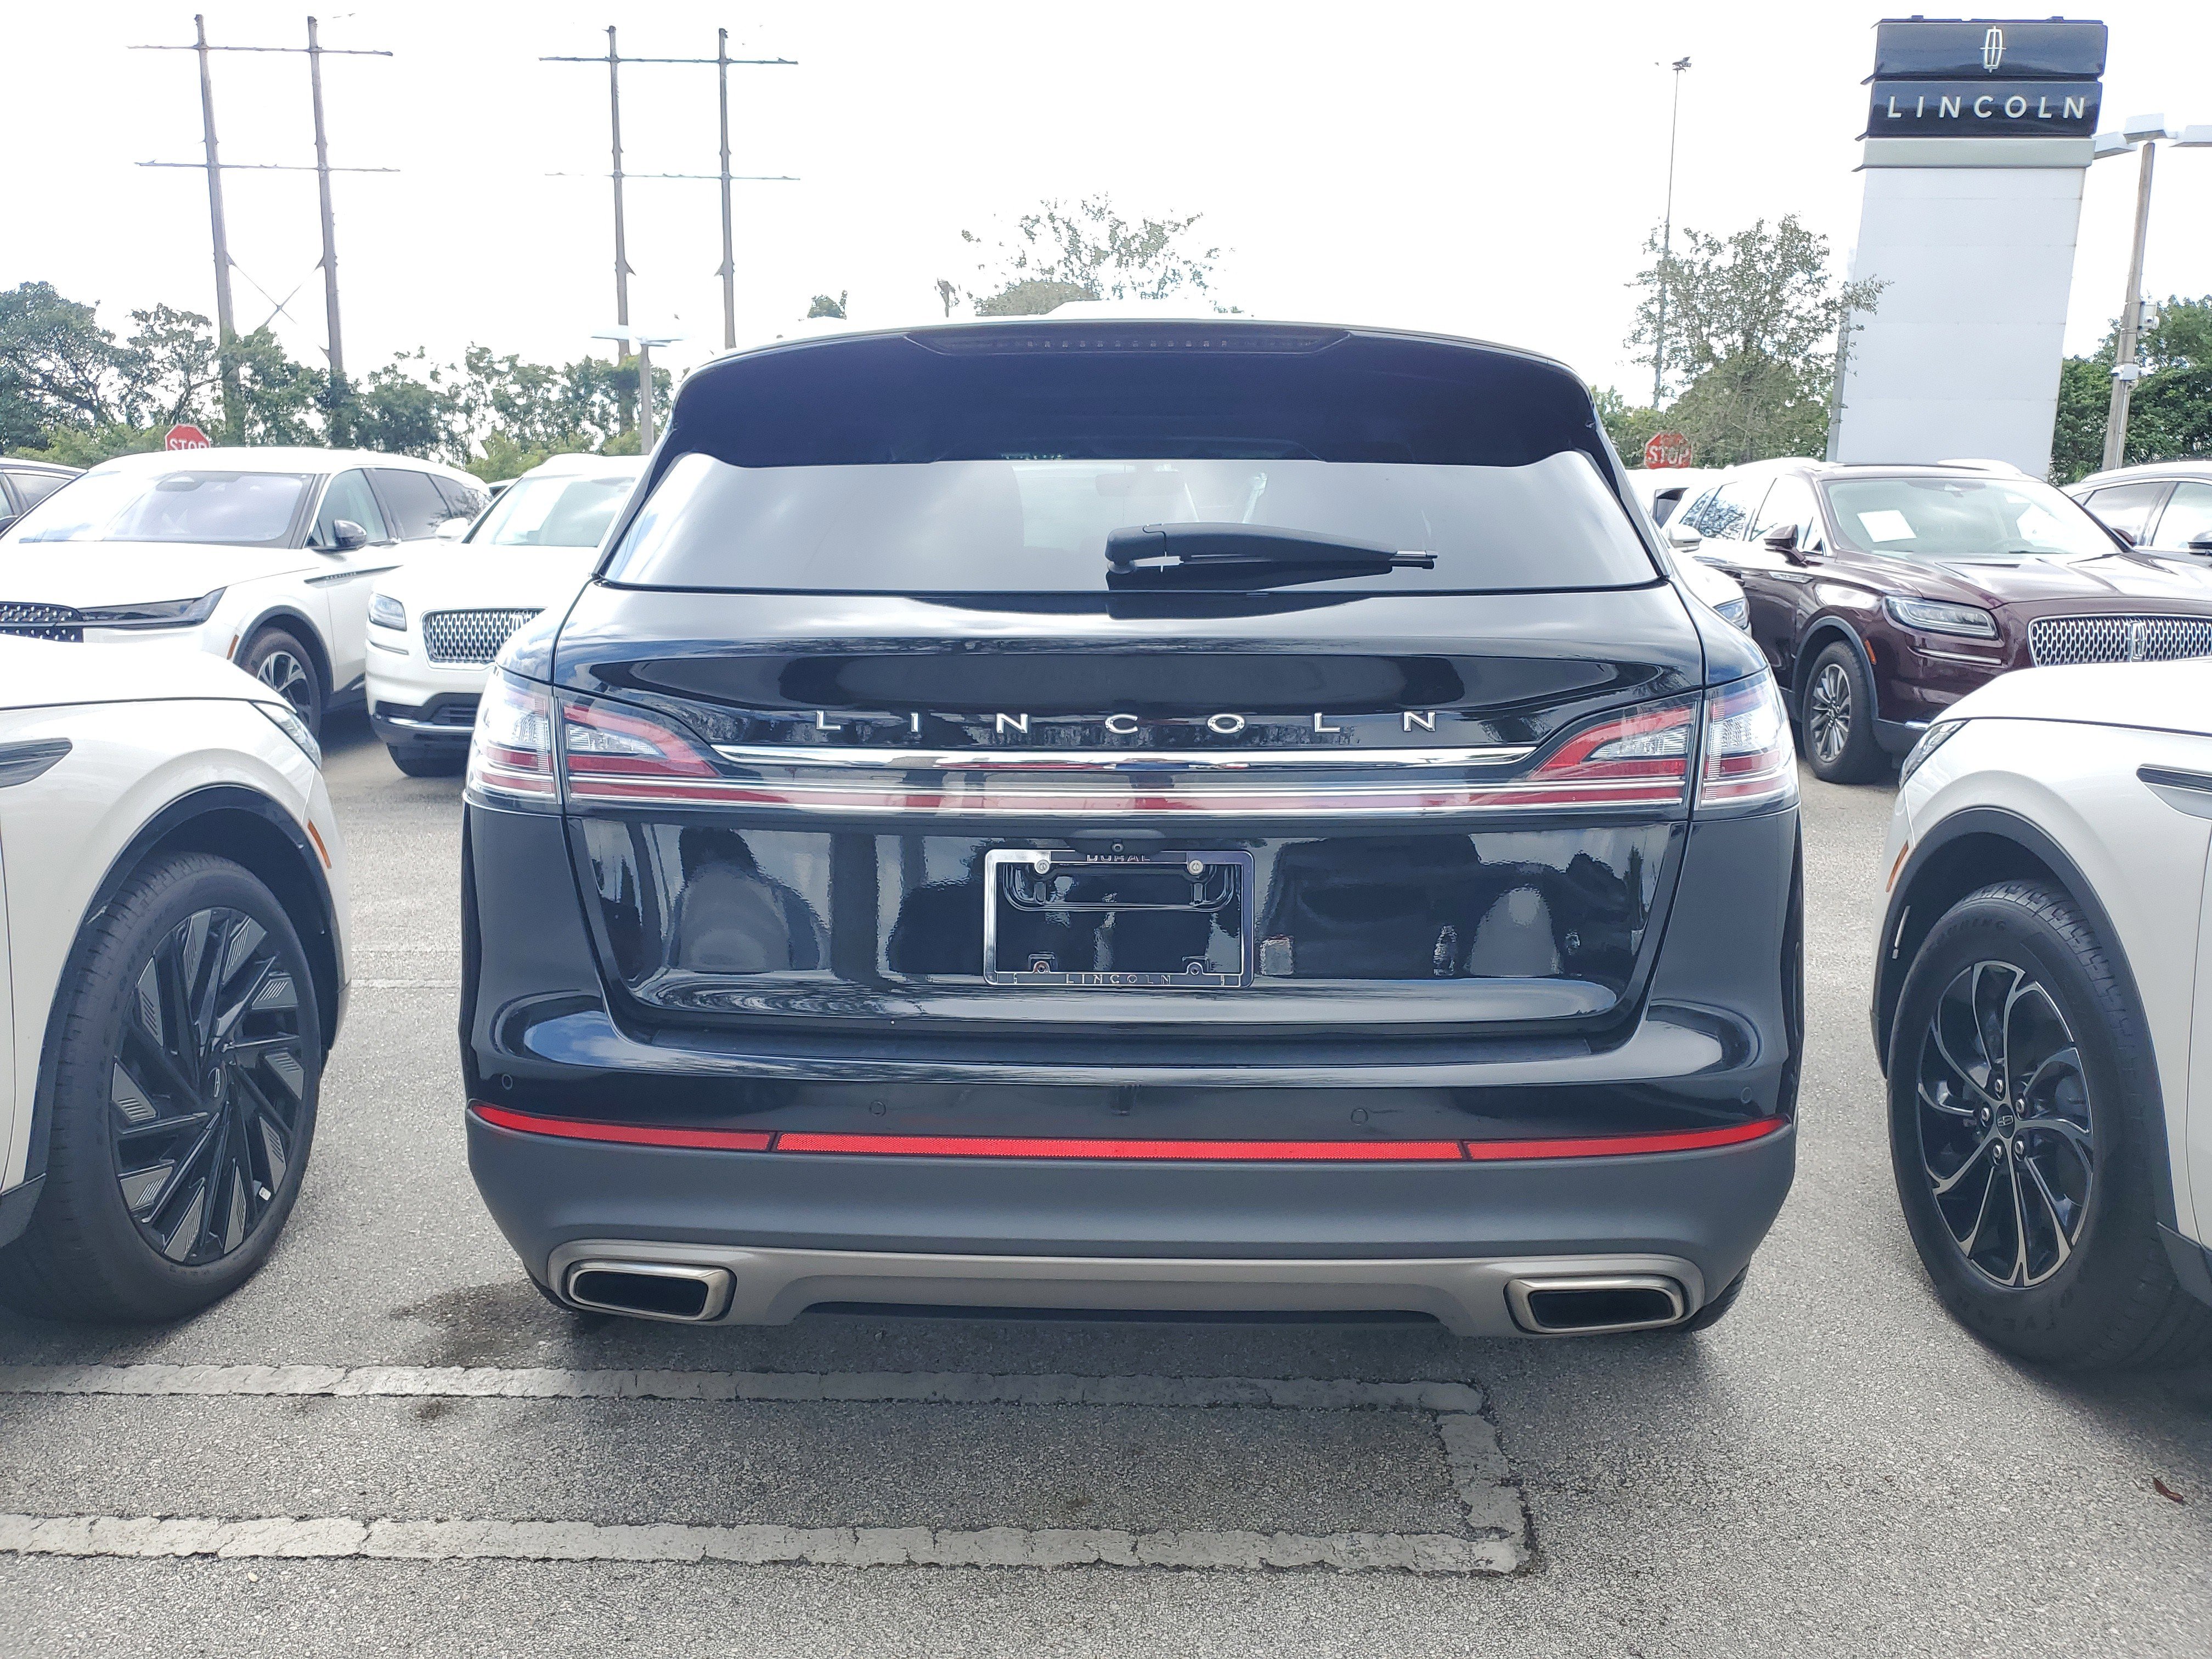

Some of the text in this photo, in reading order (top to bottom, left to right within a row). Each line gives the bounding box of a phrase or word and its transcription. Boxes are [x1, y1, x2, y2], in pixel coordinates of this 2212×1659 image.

[1888, 95, 2085, 119] LINCOLN
[815, 710, 1436, 734] LINCOLN
[1066, 974, 1171, 984] LINCOLN
